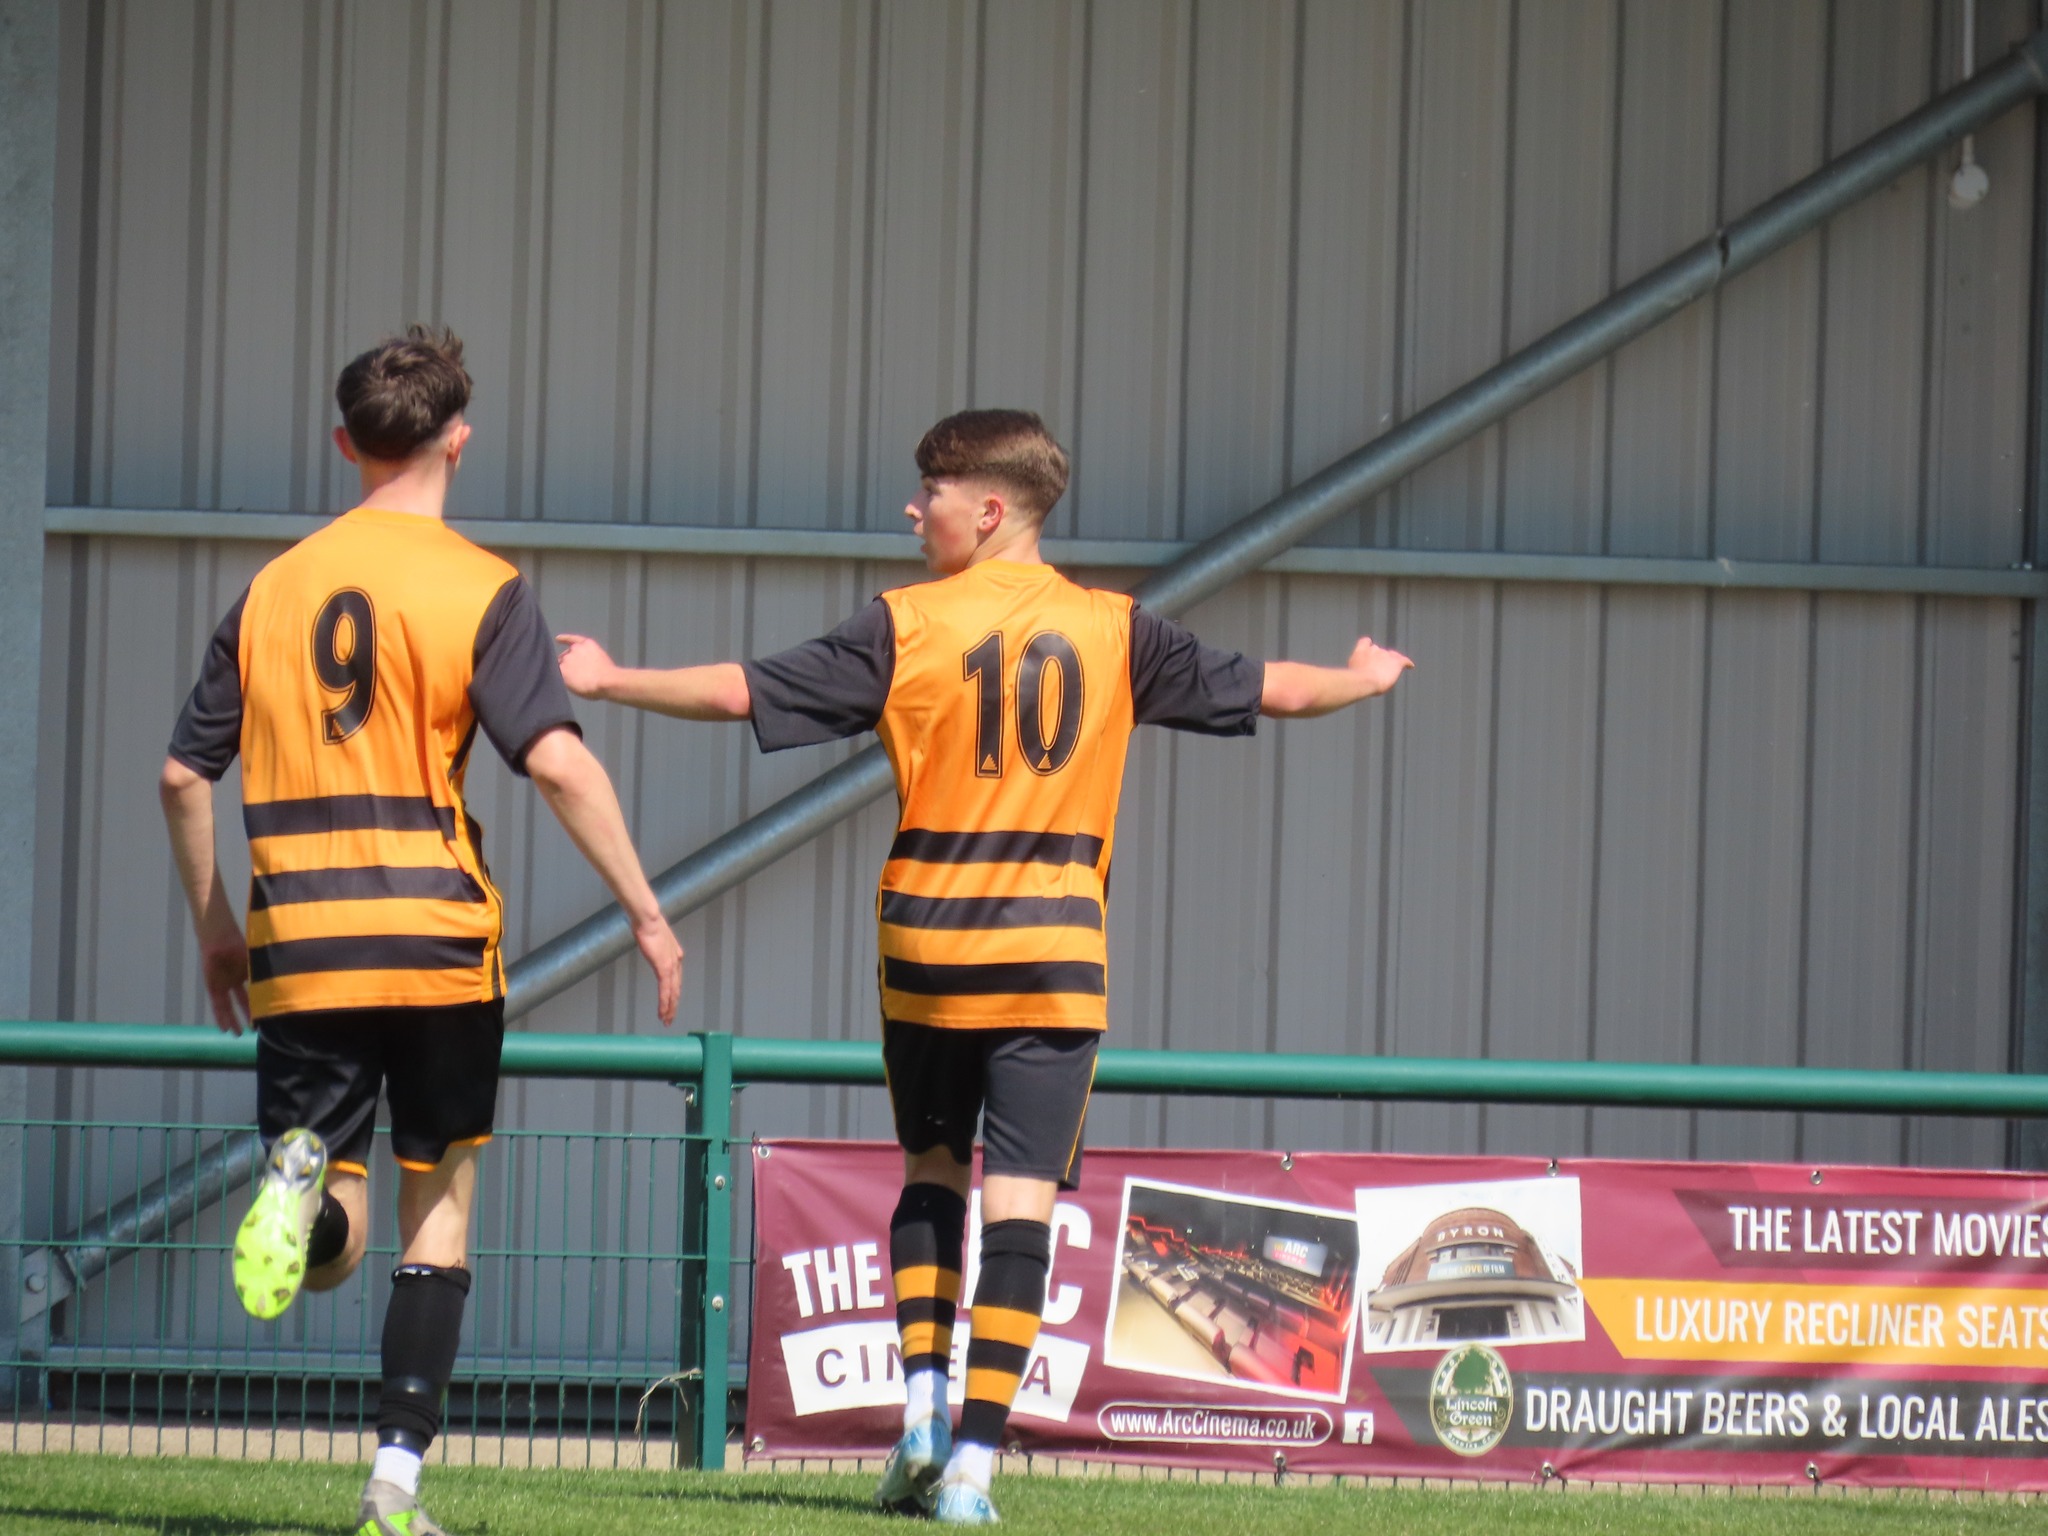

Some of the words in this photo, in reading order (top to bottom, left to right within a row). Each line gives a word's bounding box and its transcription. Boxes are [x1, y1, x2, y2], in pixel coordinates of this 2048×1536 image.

[310, 586, 377, 746] 9
[963, 630, 1085, 778] 10
[1437, 1226, 1504, 1242] BYRON
[1727, 1206, 1791, 1252] THE
[1804, 1208, 1922, 1255] LATEST
[782, 1242, 885, 1318] THE
[1635, 1296, 1771, 1344] LUXURY
[1784, 1301, 1945, 1348] RECLINER
[1110, 1409, 1315, 1439] www.ArcCinema.co.uk
[1446, 1397, 1498, 1412] Lincoln
[1449, 1411, 1492, 1426] Green
[1526, 1388, 1693, 1436] DRAUGHT
[1702, 1390, 1809, 1437] BEERS
[1821, 1393, 1847, 1438] &
[1859, 1394, 1965, 1441] LOCAL
